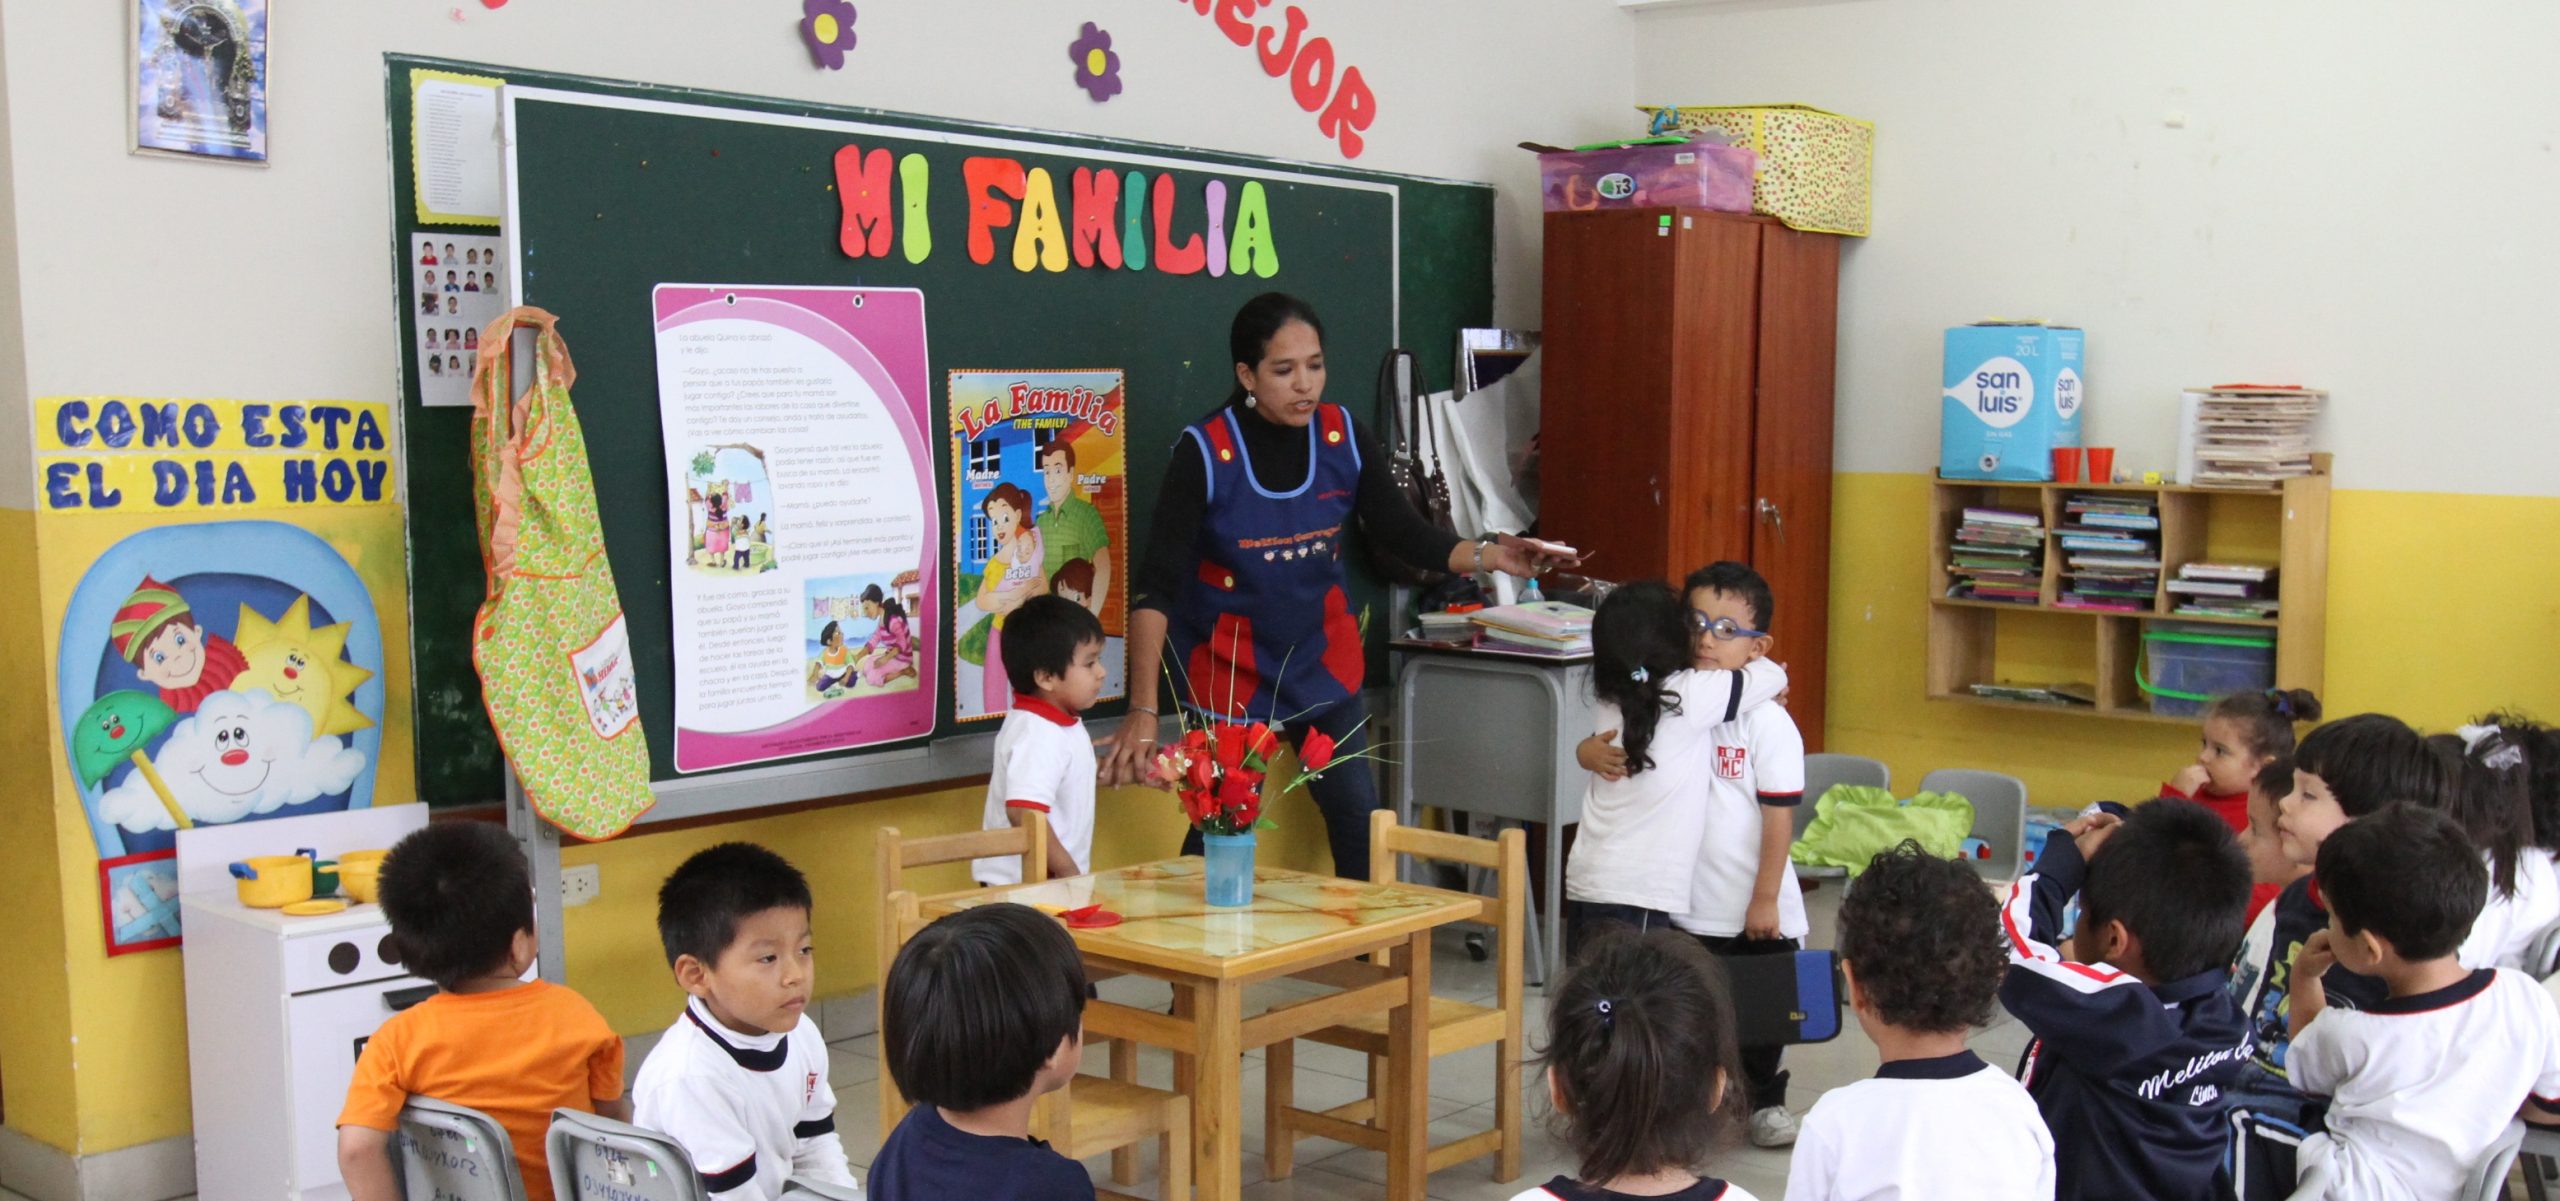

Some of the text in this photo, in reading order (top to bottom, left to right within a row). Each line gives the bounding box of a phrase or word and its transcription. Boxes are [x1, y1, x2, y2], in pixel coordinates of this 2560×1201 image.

[1179, 0, 1376, 159] EJOR
[834, 144, 1279, 278] MI FAMILIA
[2016, 345, 2031, 356] 20
[1976, 372, 2020, 389] san
[2058, 378, 2075, 391] san
[1979, 391, 2019, 413] luis
[2059, 394, 2075, 409] luis
[957, 382, 1118, 443] La Familia
[56, 400, 385, 450] COMO ESTA
[1013, 418, 1068, 430] (THE FAMILY)
[47, 458, 387, 509] EL DIA HOY
[965, 468, 1000, 481] Madre
[1077, 474, 1106, 485] Padre
[1005, 566, 1031, 579] Bebé
[1721, 757, 1741, 777] MC
[2138, 1030, 2254, 1100] Meliton Ca
